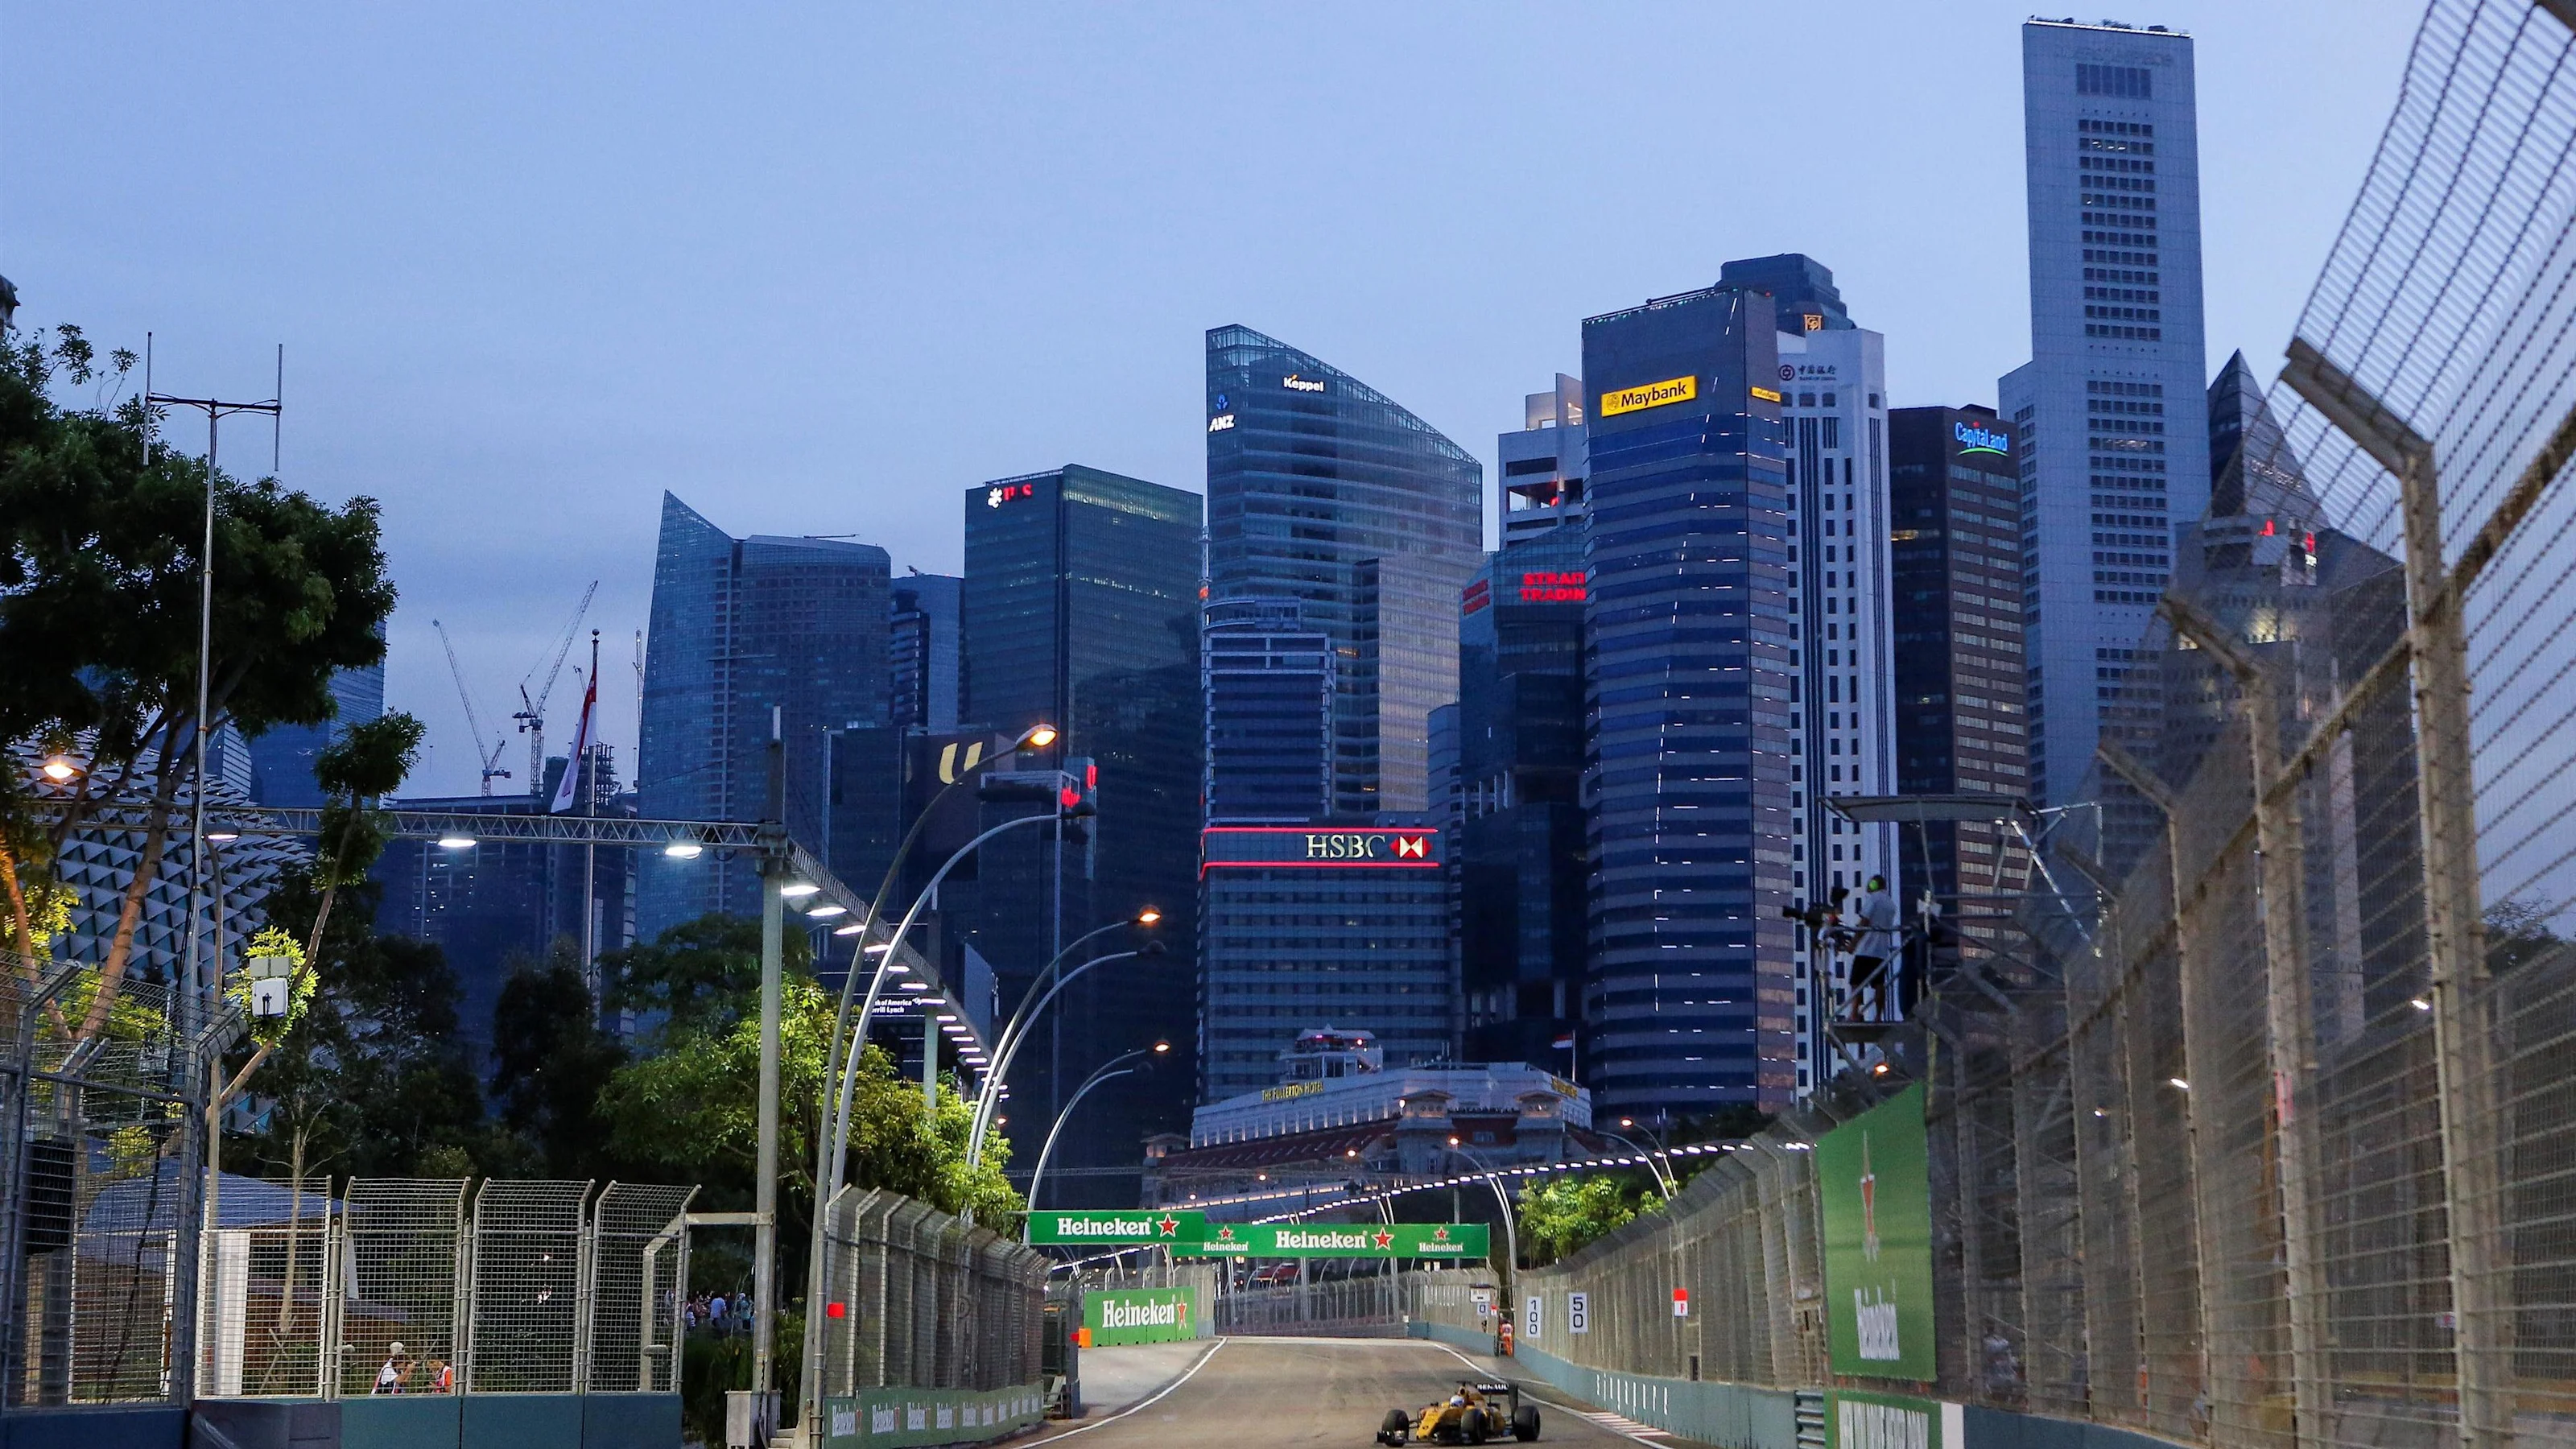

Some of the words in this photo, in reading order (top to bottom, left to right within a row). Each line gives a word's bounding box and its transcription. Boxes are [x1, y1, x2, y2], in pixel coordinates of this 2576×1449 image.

[1283, 376, 1324, 392] Keppel
[1621, 382, 1687, 407] Maybank
[1209, 415, 1234, 431] ANZ
[1955, 421, 2008, 451] CapitaLand
[1306, 834, 1385, 858] HSBC
[1057, 1217, 1151, 1236] Heineken
[1203, 1241, 1249, 1252] Heineken
[1275, 1230, 1367, 1249] Heineken
[1418, 1242, 1463, 1252] Heineken
[1102, 1298, 1175, 1328] Heineken
[1573, 1297, 1583, 1328] 50
